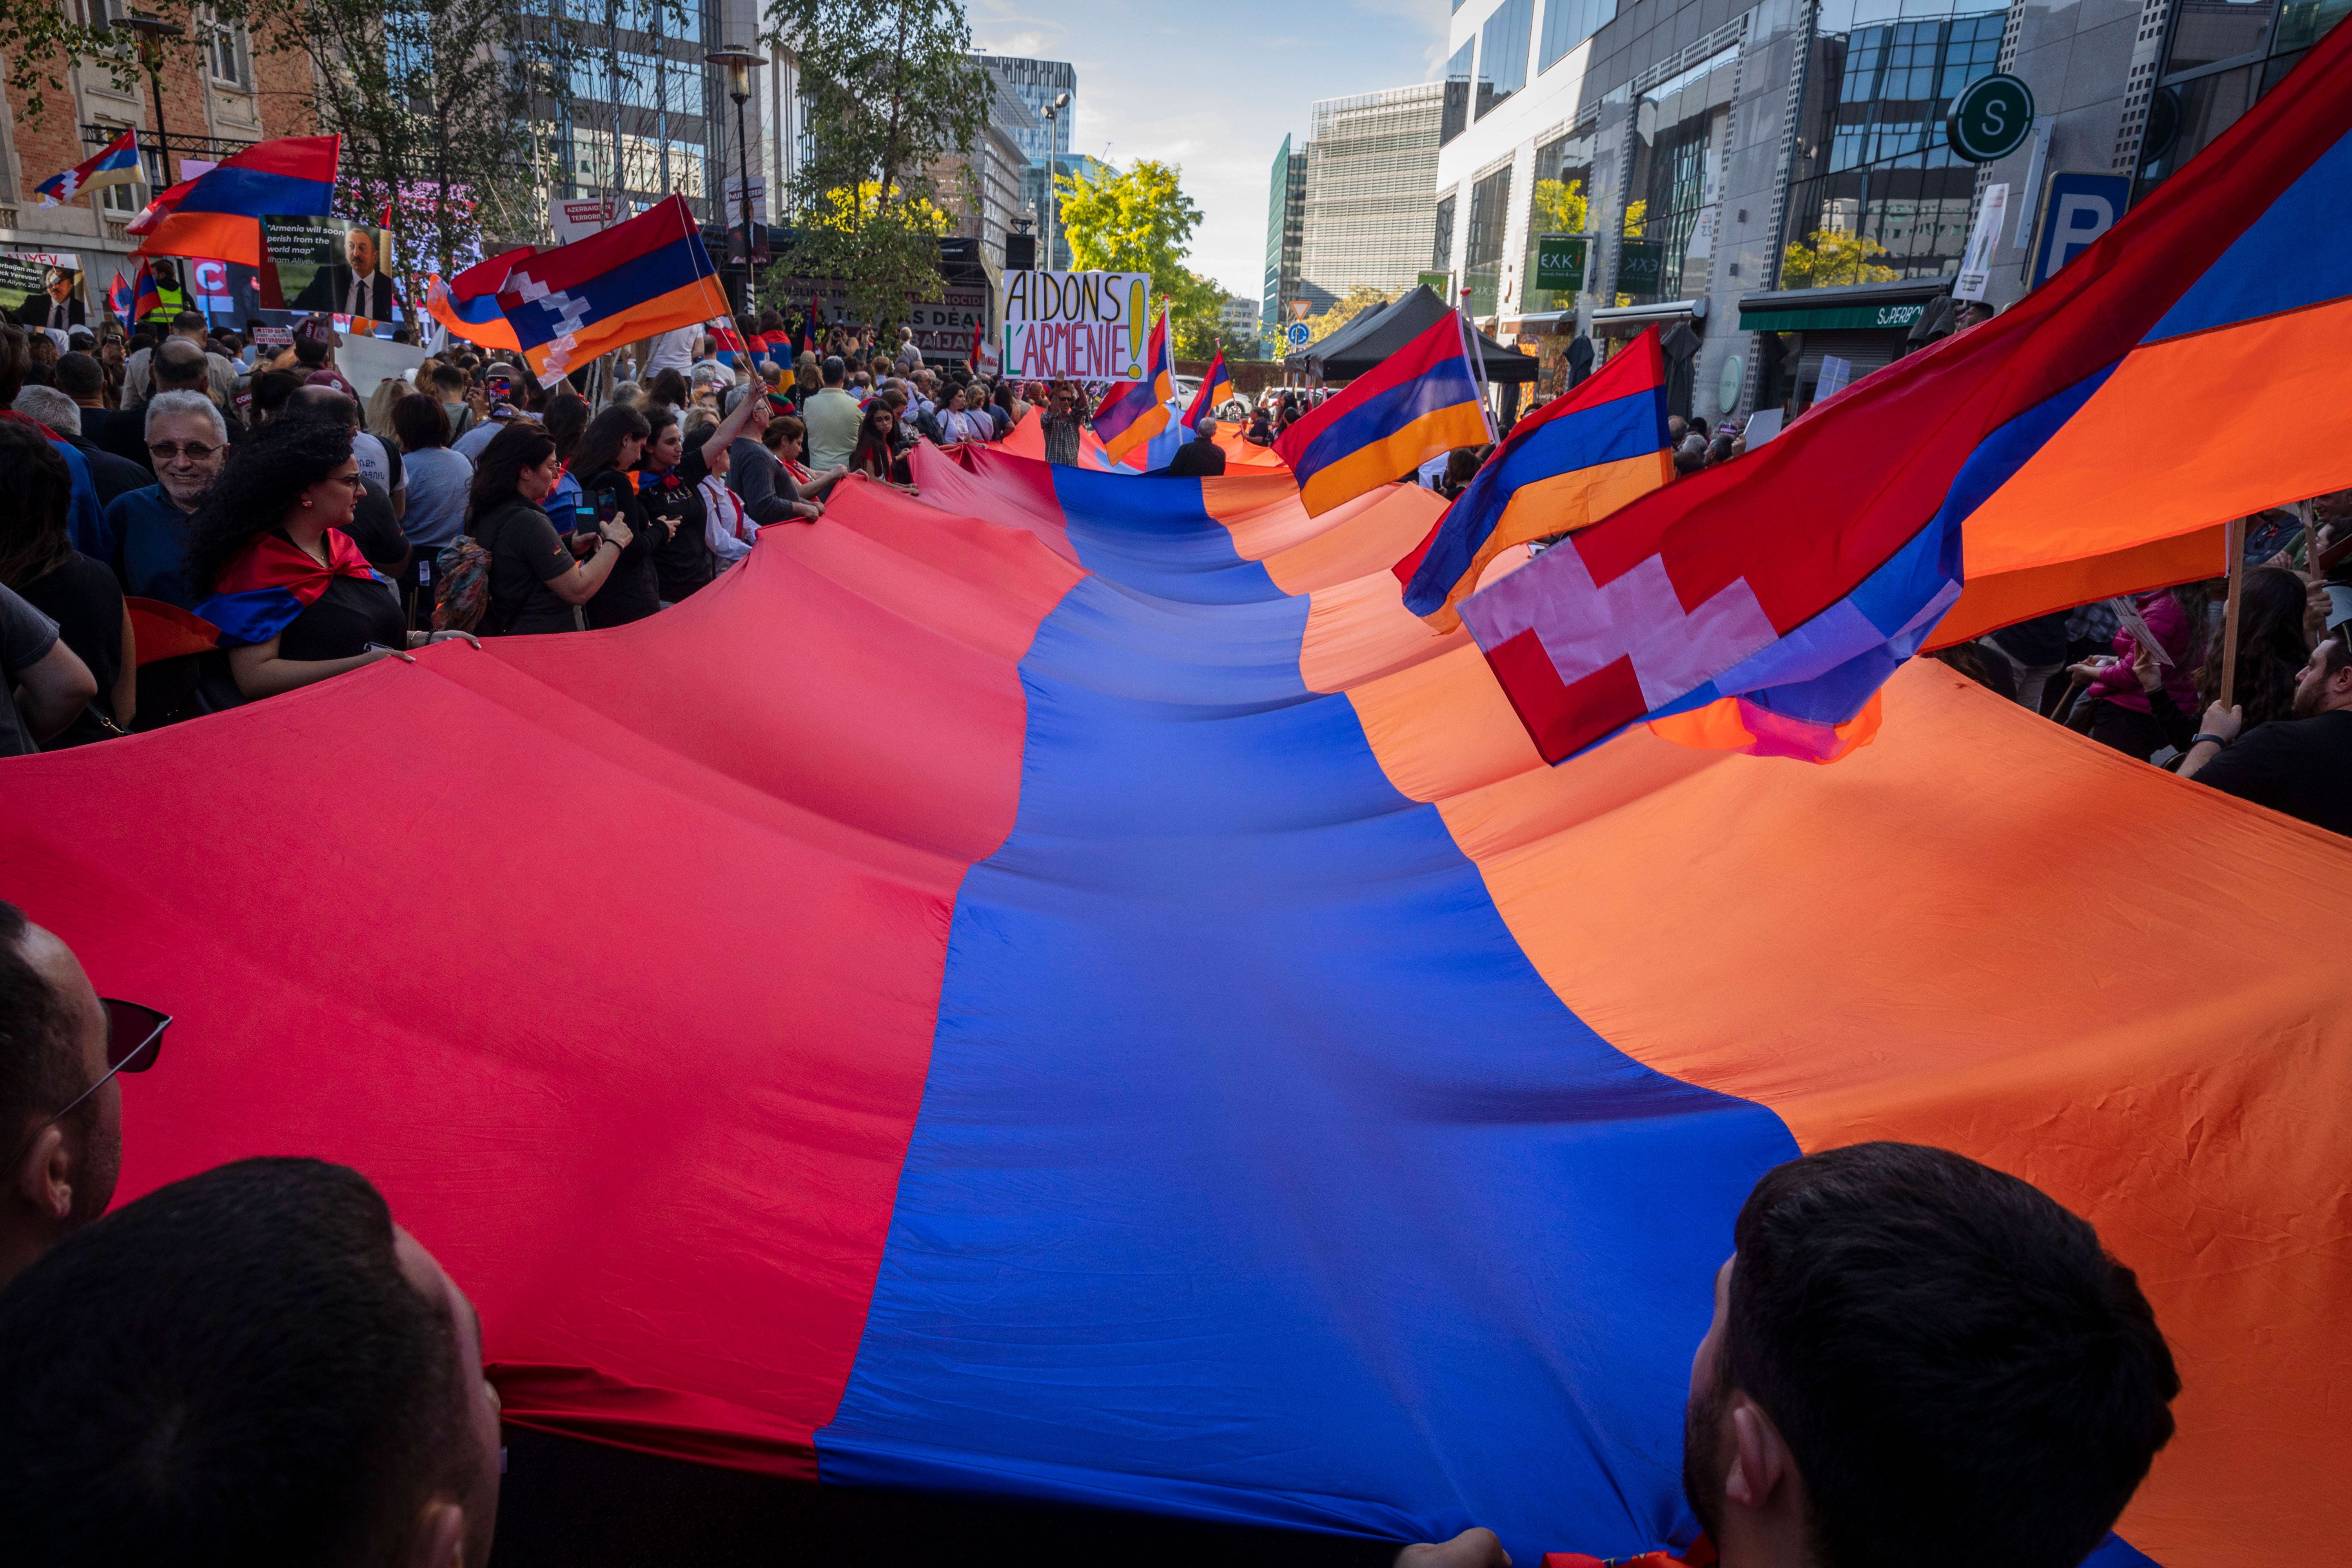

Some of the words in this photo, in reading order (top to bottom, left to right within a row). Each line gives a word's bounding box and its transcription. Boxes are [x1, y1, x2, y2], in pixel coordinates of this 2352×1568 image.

[1982, 99, 2007, 136] S
[2045, 194, 2113, 279] P
[291, 258, 315, 266] Aliyev
[1541, 253, 1573, 269] EXK
[7, 279, 27, 287] Aliyev,
[11, 272, 40, 281] Yerevan"
[1004, 270, 1122, 323] AIDONS
